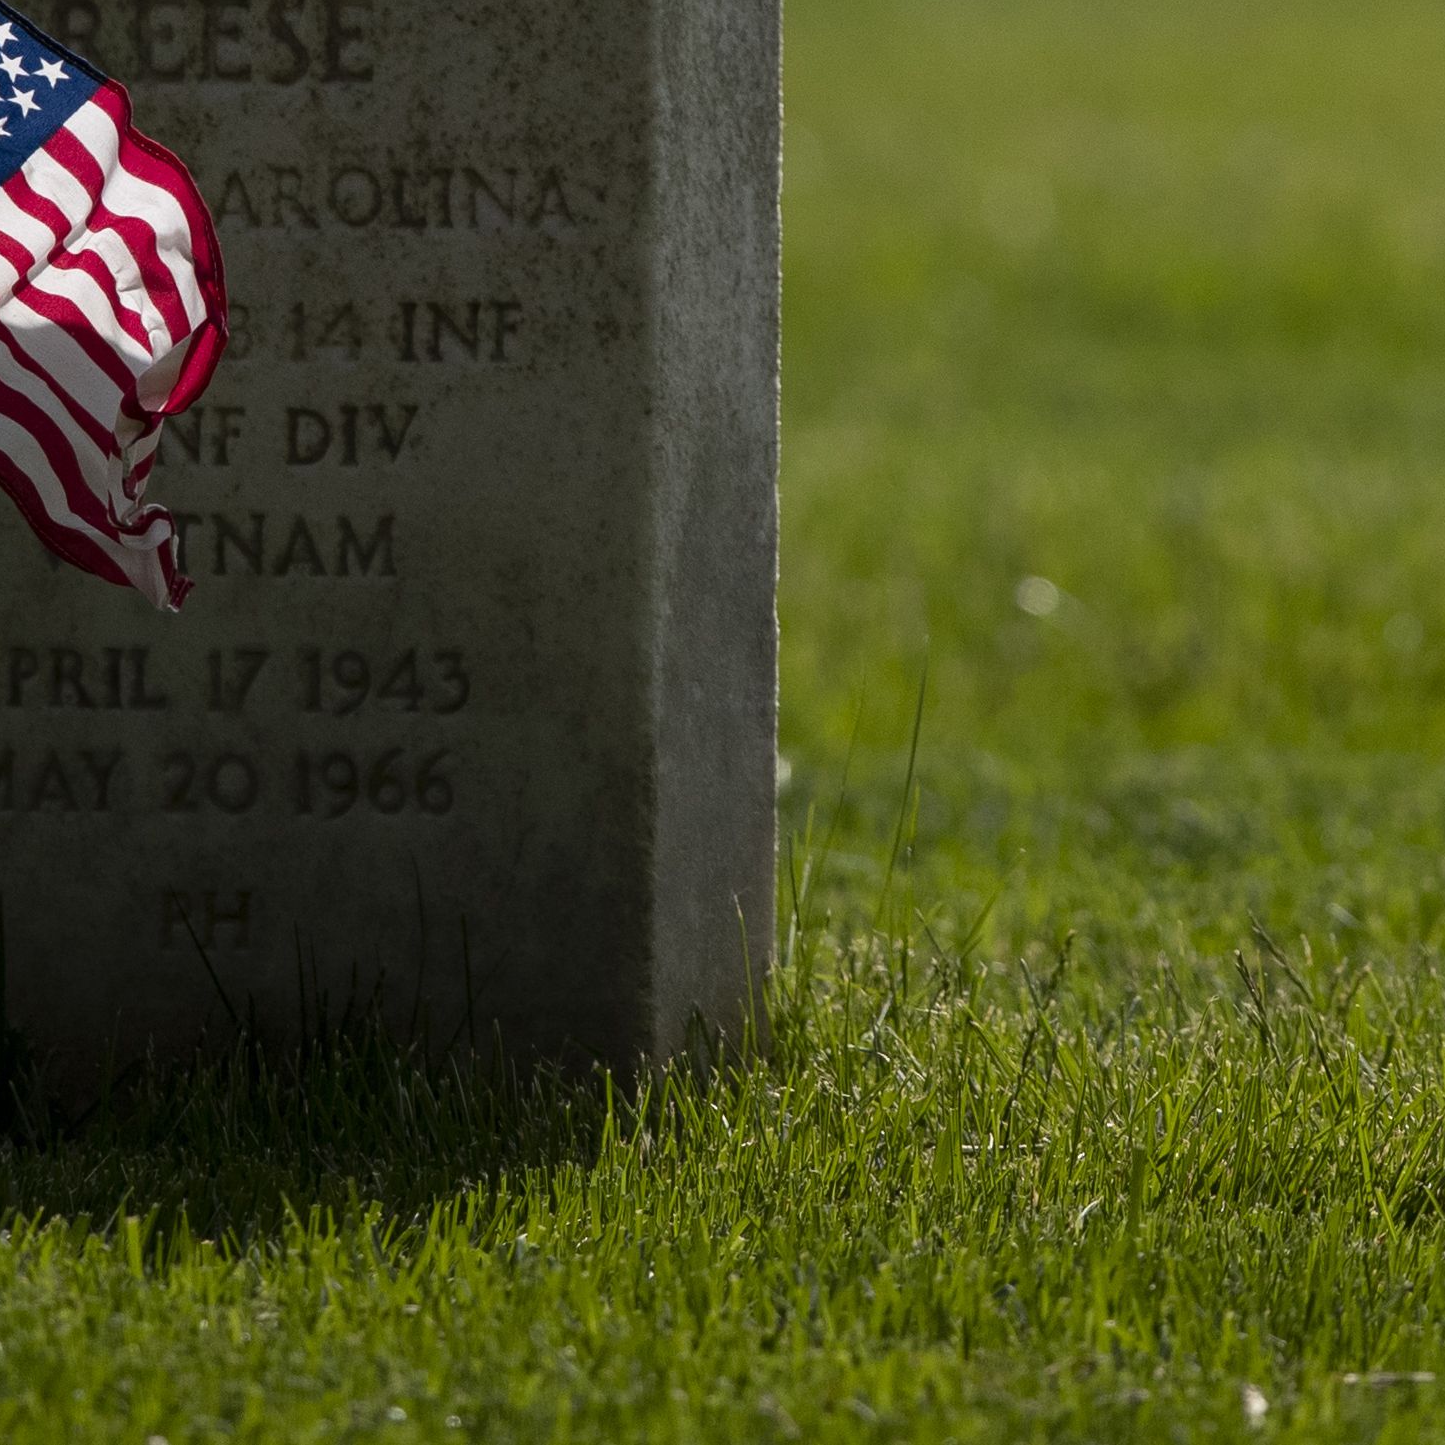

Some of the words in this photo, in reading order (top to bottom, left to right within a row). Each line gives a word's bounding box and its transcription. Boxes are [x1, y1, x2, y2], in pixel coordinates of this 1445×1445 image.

[216, 164, 581, 230] AROLINA
[290, 300, 363, 362] 14
[397, 299, 523, 364] INF
[156, 406, 246, 467] NF
[285, 404, 421, 467] DIV
[170, 512, 399, 578] TNAM
[204, 647, 269, 713] 17
[298, 646, 472, 716] 1943
[162, 750, 257, 816] 20
[291, 746, 455, 820] 1966
[158, 889, 254, 950] PH
